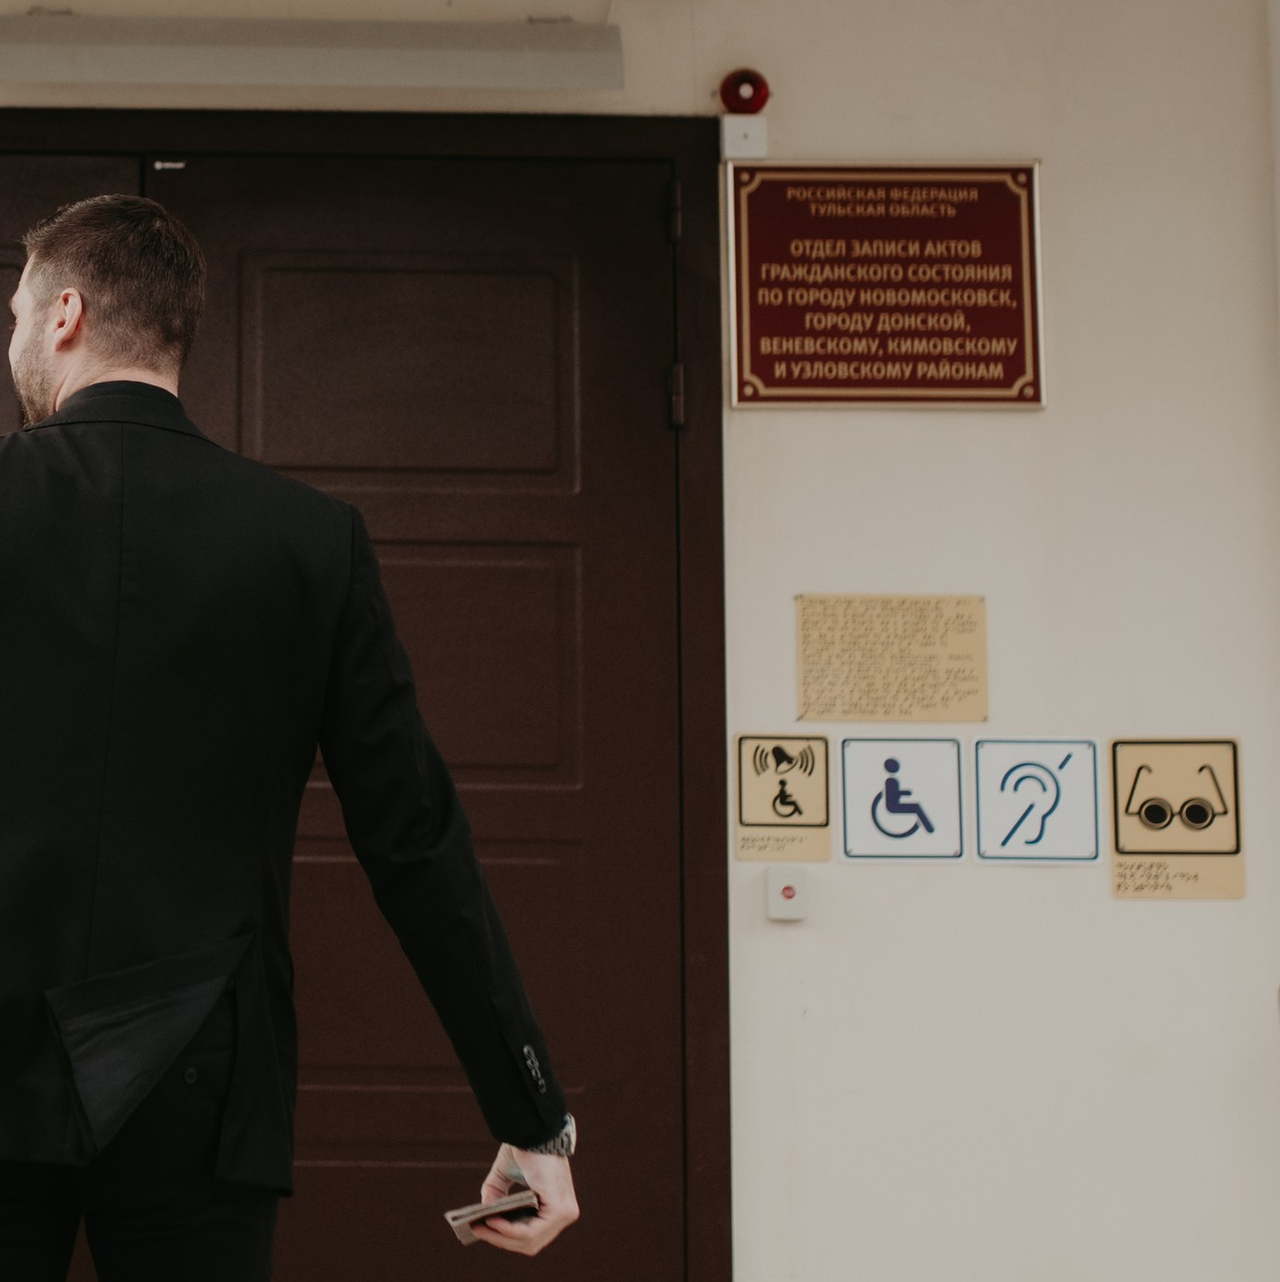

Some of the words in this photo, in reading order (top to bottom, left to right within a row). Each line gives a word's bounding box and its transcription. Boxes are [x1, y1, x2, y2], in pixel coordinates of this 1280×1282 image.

[787, 185, 886, 202] РОССИЙСКАЯ
[889, 187, 979, 203] ФЕДЕРАЦИЯ
[810, 203, 886, 217] ТУЛЬСКАЯ
[889, 203, 957, 218] ОБЛАСТЬ
[790, 239, 846, 260] ОТДЕЛ
[851, 239, 921, 257] ЗАПИСИ
[924, 239, 982, 257] АКТОВ
[761, 263, 903, 284] ГРАЖДАНСКОГО
[907, 264, 1012, 283] СОСТОЯНИЯ
[758, 288, 783, 306] ПО
[787, 288, 856, 308] ГОРОДУ
[860, 288, 1017, 309] НОВОМОСКОВСК,
[805, 313, 874, 333] ГОРОДУ
[877, 309, 971, 333] ДОНСКОЙ,
[760, 337, 884, 358] ВЕНЕВСКОМУ,
[888, 337, 1018, 356] КИМОВСКОМУ
[774, 361, 787, 379] И
[790, 361, 913, 380] УЗЛОВСКОМУ
[917, 358, 1004, 380] РАЙОНАМ
